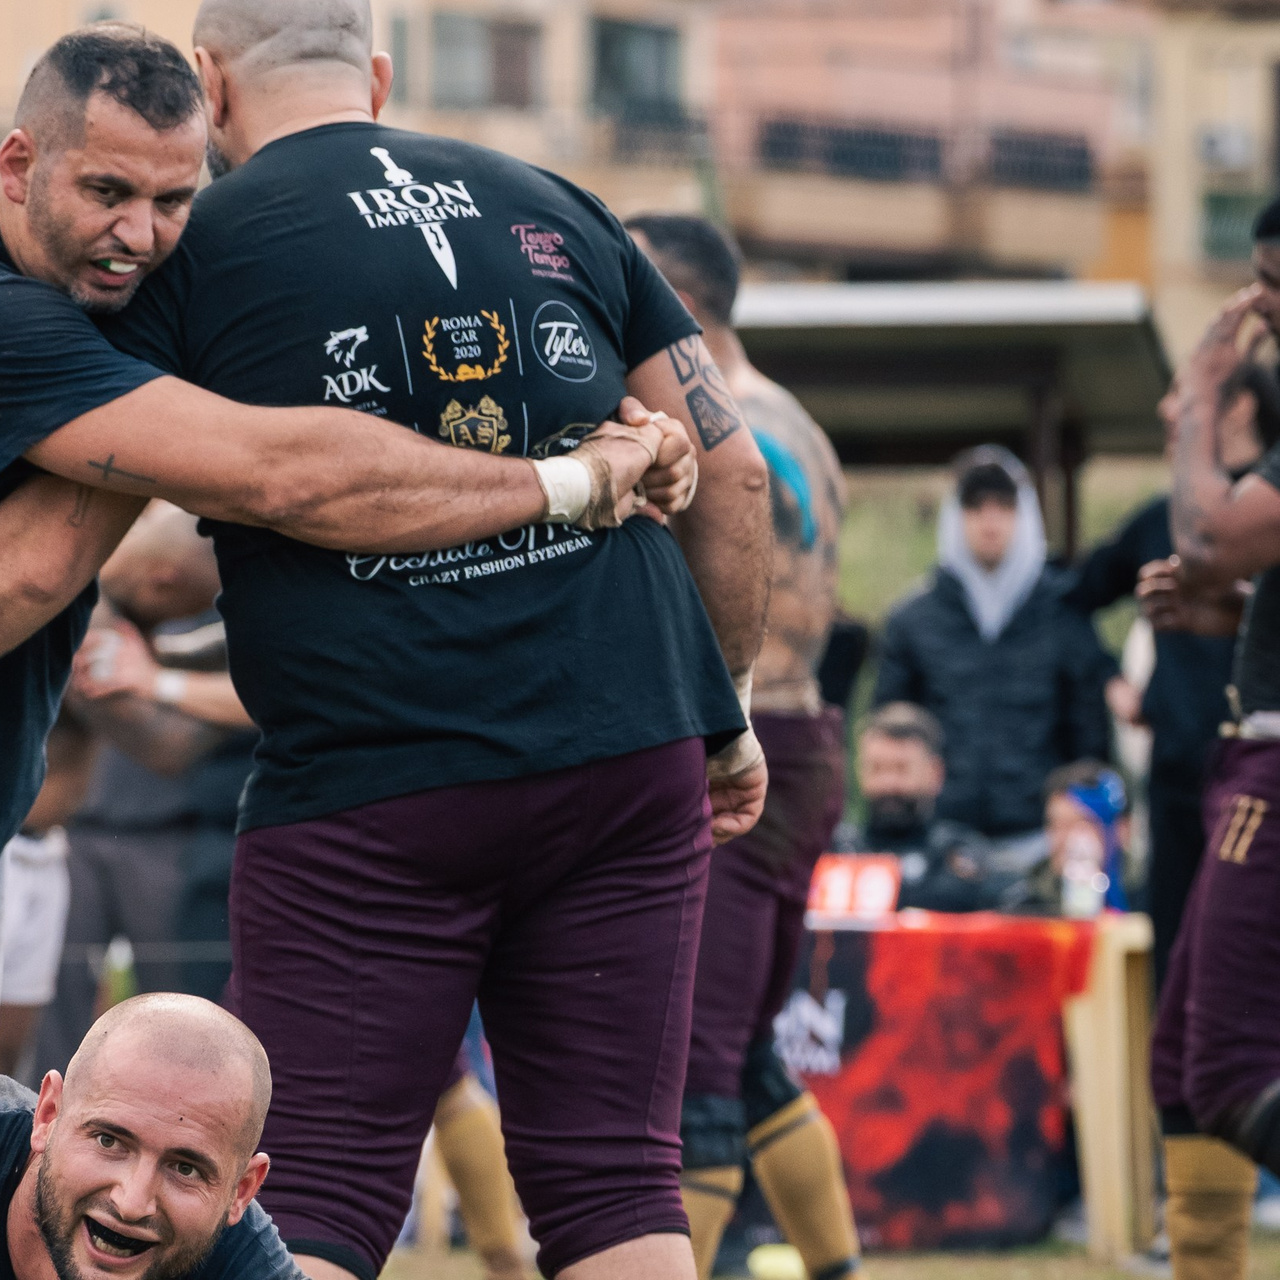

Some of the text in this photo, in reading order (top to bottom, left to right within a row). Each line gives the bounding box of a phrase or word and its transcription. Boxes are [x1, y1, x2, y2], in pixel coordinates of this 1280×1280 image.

[346, 179, 474, 215] IRON
[363, 203, 483, 229] IMPERIVM
[521, 244, 571, 271] Tempo
[440, 315, 483, 332] ROMA
[450, 329, 478, 344] CAR
[452, 344, 482, 360] 2020
[538, 320, 590, 366] Tyler
[321, 364, 391, 403] ADK
[408, 568, 461, 587] CRAZY
[464, 553, 525, 580] FASHION
[528, 535, 593, 564] EYEWEAR
